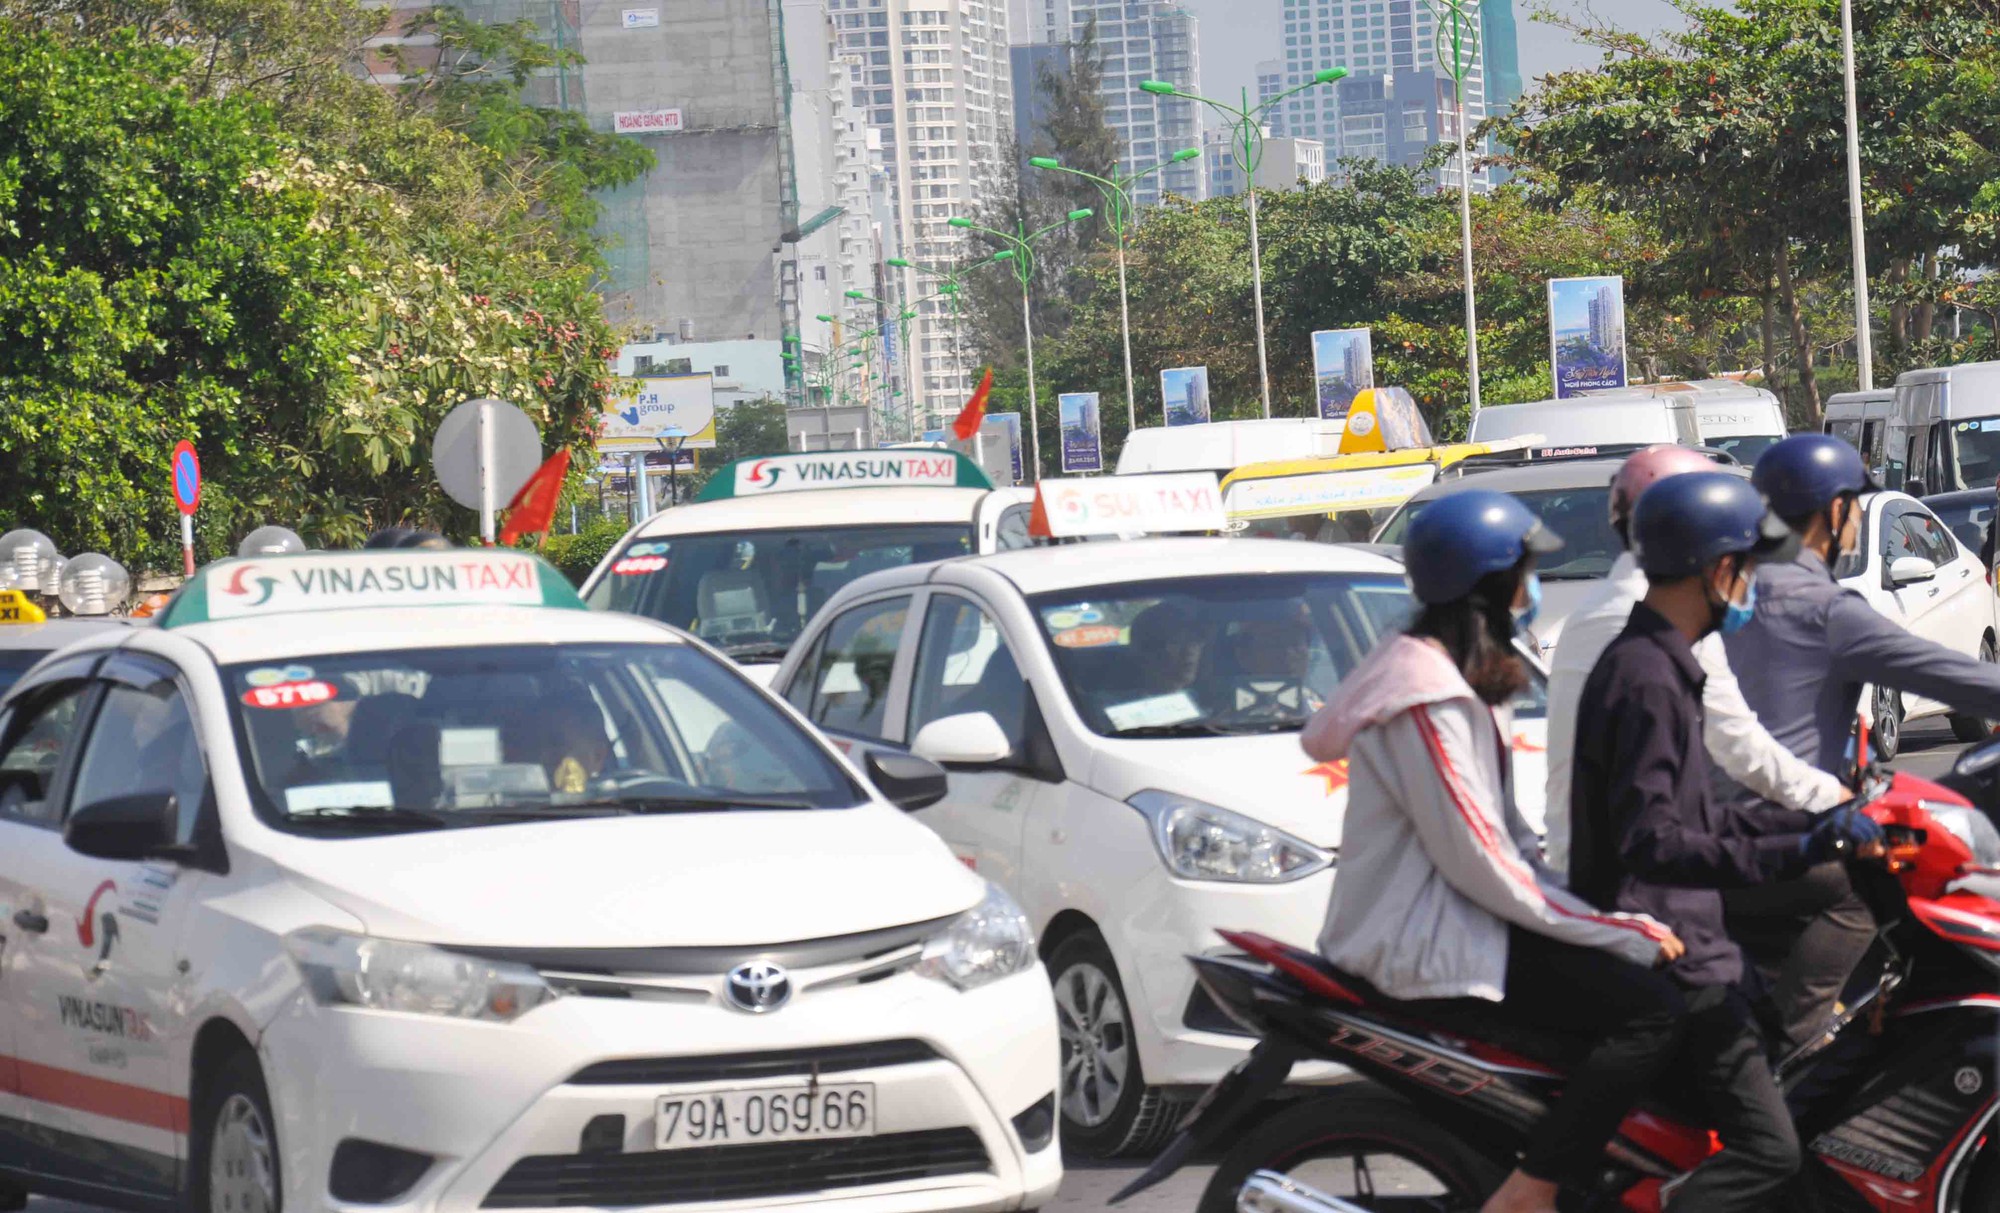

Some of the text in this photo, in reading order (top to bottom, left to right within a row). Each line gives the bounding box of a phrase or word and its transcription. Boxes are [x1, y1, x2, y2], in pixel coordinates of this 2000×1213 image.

[1580, 380, 1600, 388] PHONG
[638, 402, 675, 416] group
[1093, 493, 1145, 518] SU
[664, 1090, 866, 1143] 79A-069.66
